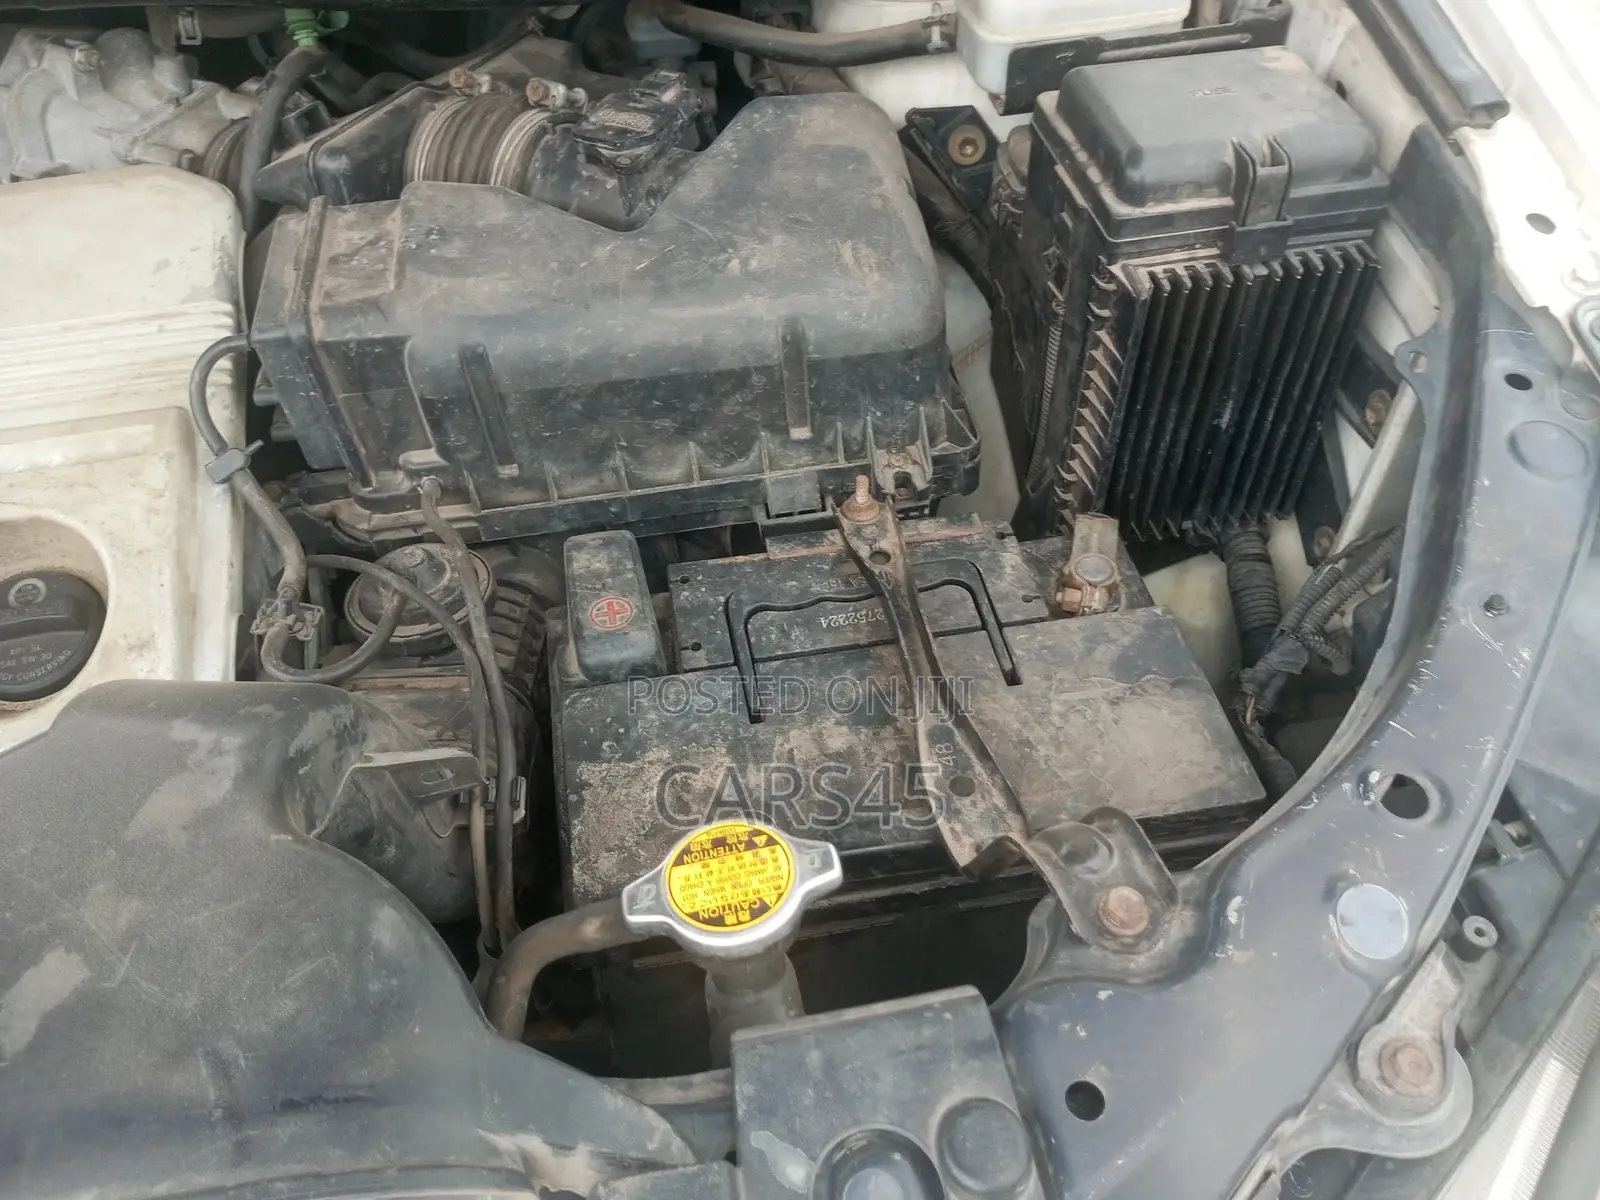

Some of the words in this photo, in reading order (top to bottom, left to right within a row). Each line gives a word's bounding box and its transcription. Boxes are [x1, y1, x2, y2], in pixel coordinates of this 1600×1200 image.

[1190, 86, 1238, 98] FUSE
[819, 608, 885, 629] 2752224
[16, 649, 72, 681] CONSERVING
[683, 842, 746, 864] ATTENTION
[699, 898, 760, 920] CAUTION
